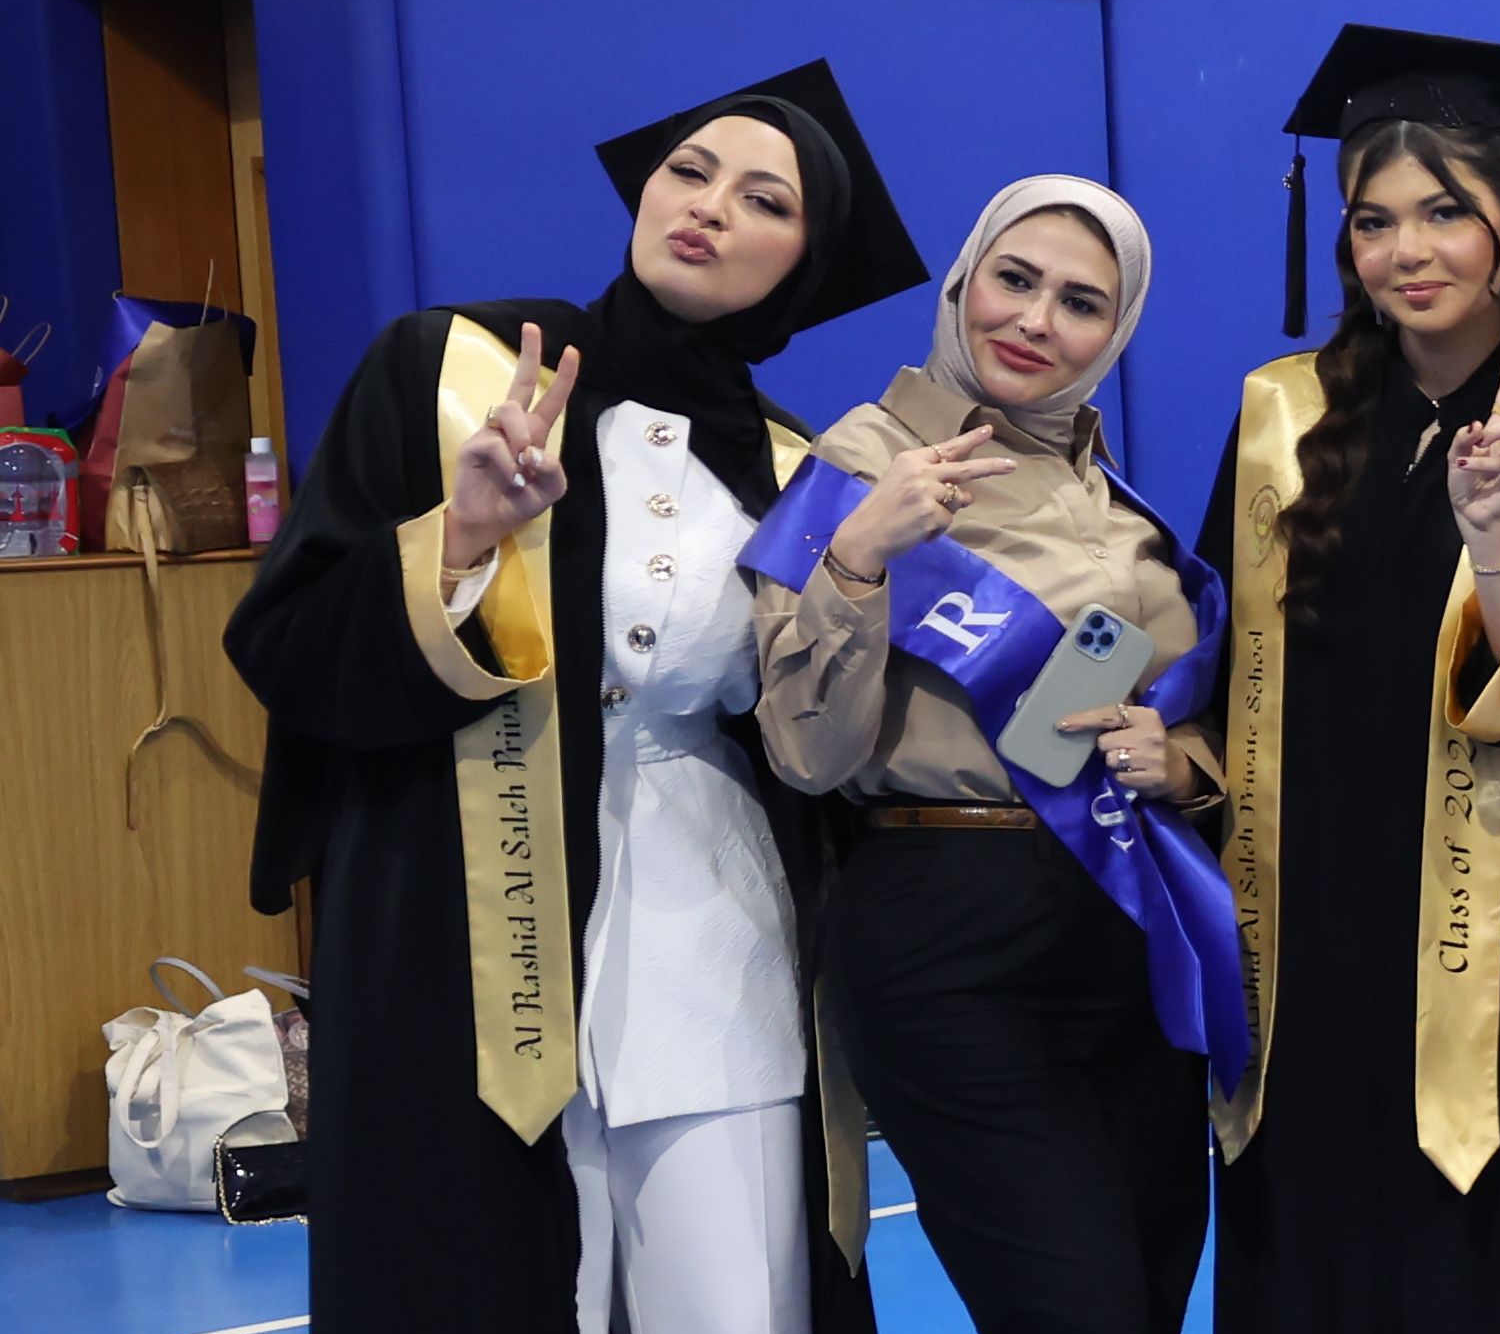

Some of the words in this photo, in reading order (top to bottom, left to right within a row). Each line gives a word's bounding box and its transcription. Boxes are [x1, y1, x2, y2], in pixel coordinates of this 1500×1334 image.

[1245, 630, 1264, 714] School
[1240, 724, 1259, 815] Private
[498, 783, 532, 861] Saleh
[1444, 835, 1472, 876] of
[504, 870, 535, 906] Al
[1237, 826, 1259, 898] Saleh
[507, 915, 544, 1016] Rashid
[1439, 887, 1471, 975] Class
[514, 1026, 543, 1061] Al
